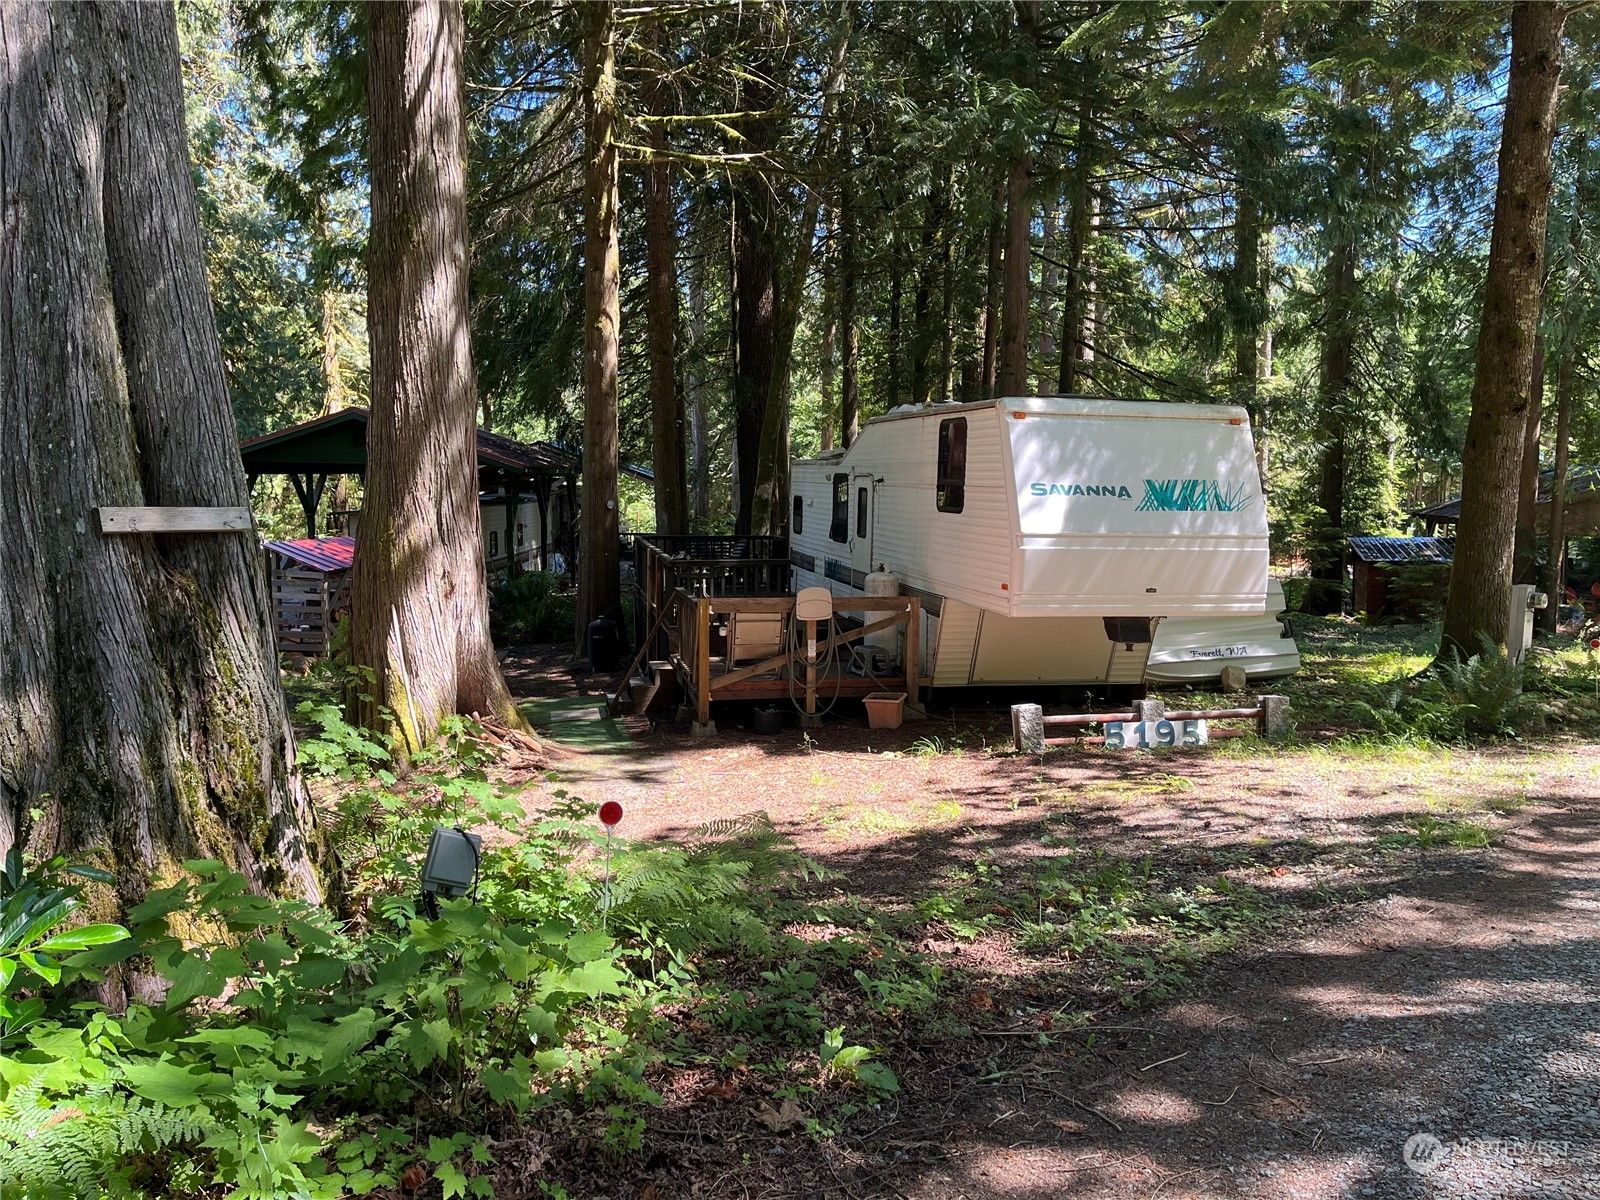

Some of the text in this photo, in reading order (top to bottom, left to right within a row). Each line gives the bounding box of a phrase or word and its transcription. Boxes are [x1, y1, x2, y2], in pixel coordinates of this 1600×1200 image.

[1030, 482, 1132, 498] SAVANNA
[1190, 646, 1248, 657] Everett, WA
[1105, 719, 1200, 748] 5195
